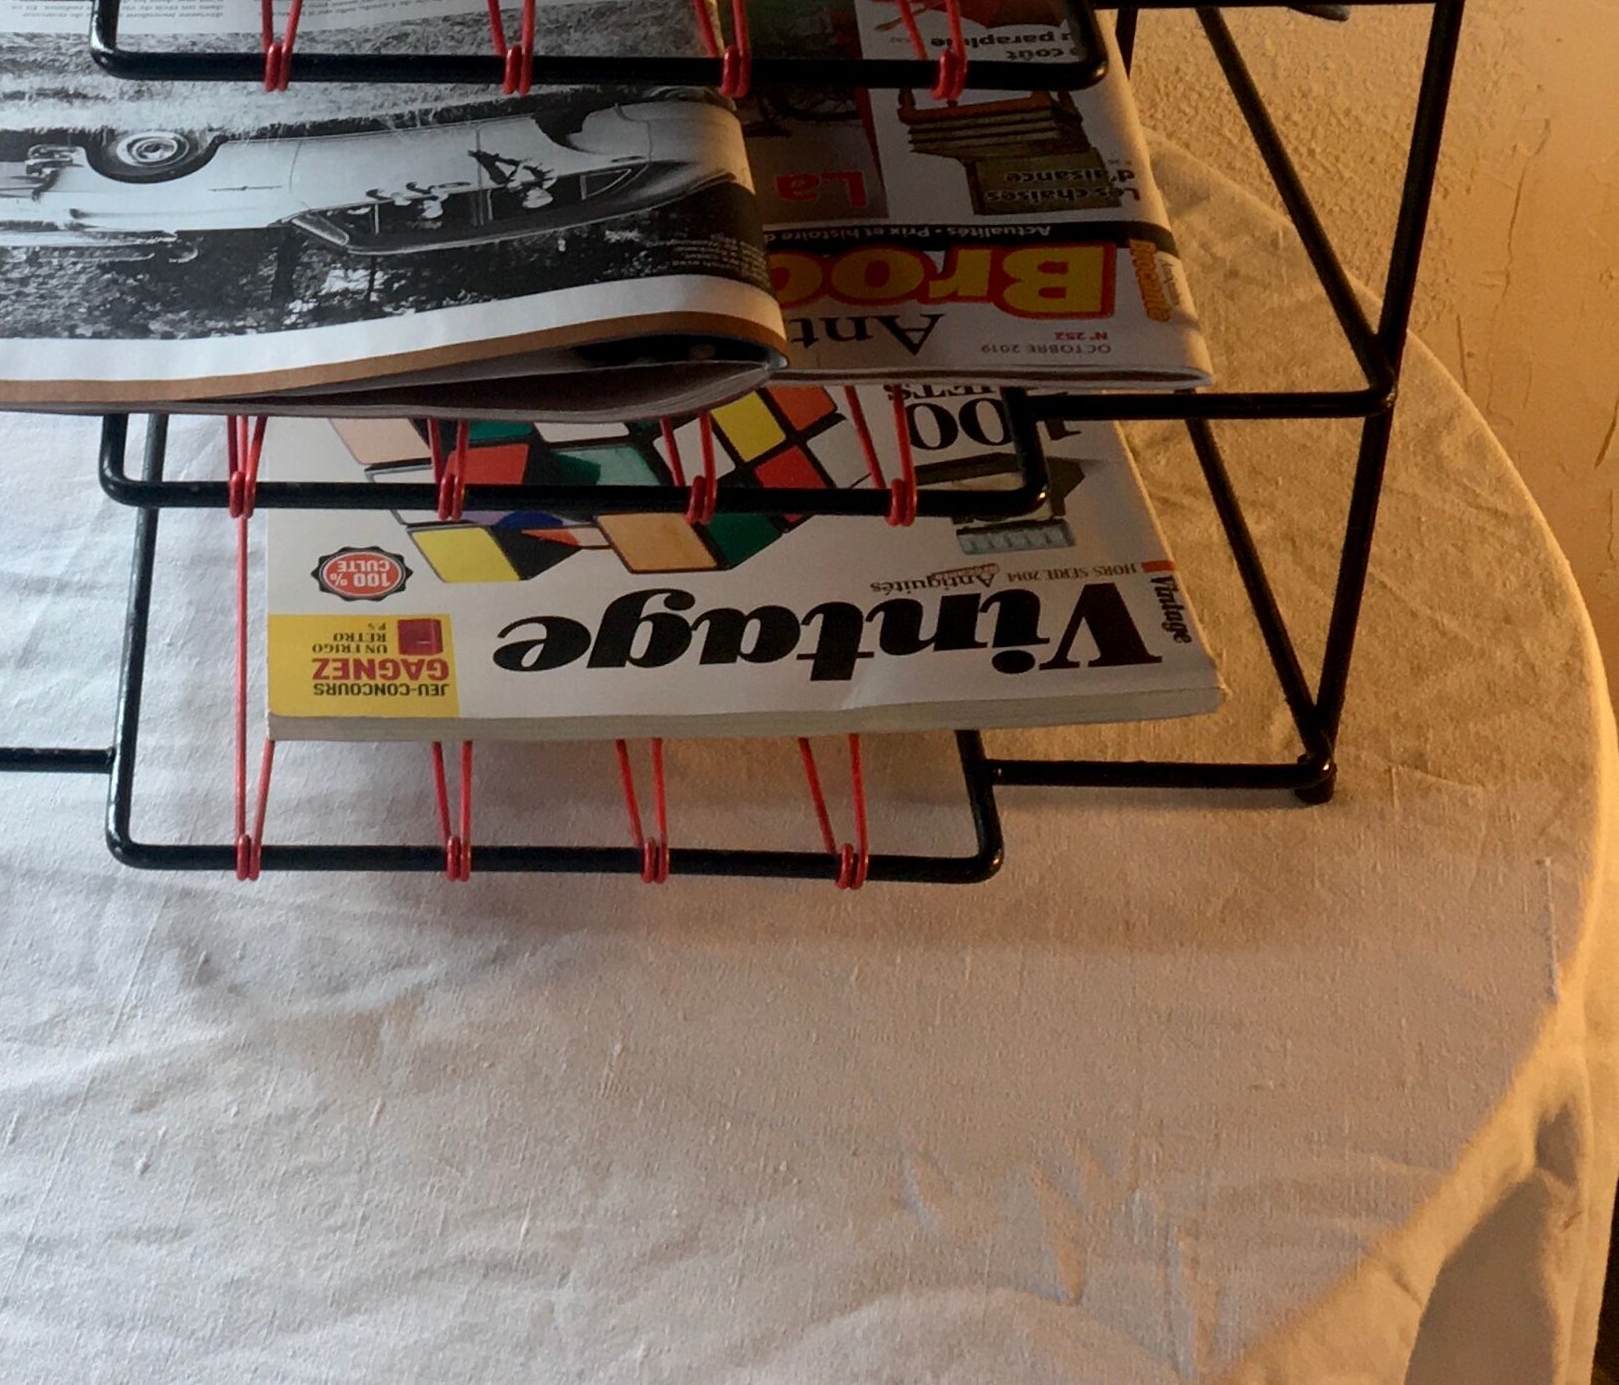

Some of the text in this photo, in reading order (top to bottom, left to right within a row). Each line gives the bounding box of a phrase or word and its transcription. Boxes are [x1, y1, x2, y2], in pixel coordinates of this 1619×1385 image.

[775, 170, 868, 208] La
[986, 187, 1142, 203] Les chaises
[791, 227, 861, 243] histoire
[864, 227, 885, 240] et
[888, 226, 931, 241] Prix
[945, 224, 1052, 239] Actualités
[980, 342, 1112, 355] OCTOBRE 2019
[337, 559, 390, 573] CULTE
[1092, 563, 1137, 577] HORS
[329, 573, 391, 588] 100 %
[869, 570, 997, 597] Antiquités
[1150, 575, 1193, 645] Vintage
[492, 582, 1163, 682] Vintage
[311, 643, 388, 654] UN FRIGO
[311, 658, 450, 682] GAGNEZ
[313, 682, 450, 697] JEU-CONCOURS
